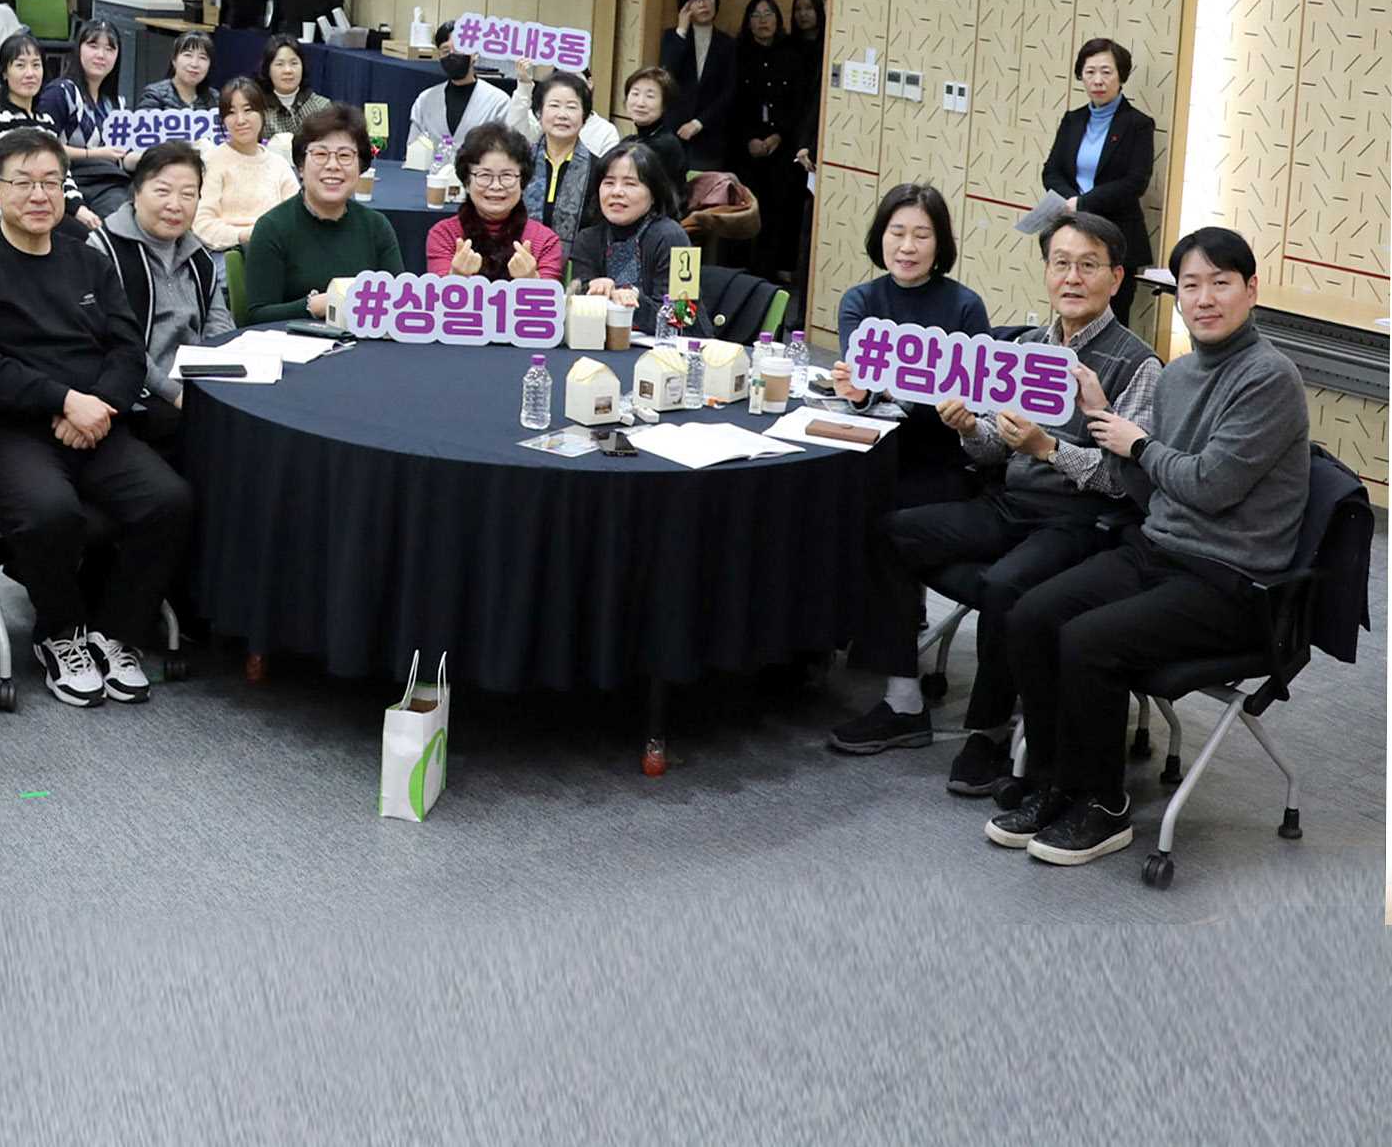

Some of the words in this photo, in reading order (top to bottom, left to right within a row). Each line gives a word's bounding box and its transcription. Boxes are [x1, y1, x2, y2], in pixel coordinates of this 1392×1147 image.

[458, 18, 586, 67] #성내3동
[352, 280, 557, 339] #상일1동
[854, 328, 1068, 416] #암사3동
